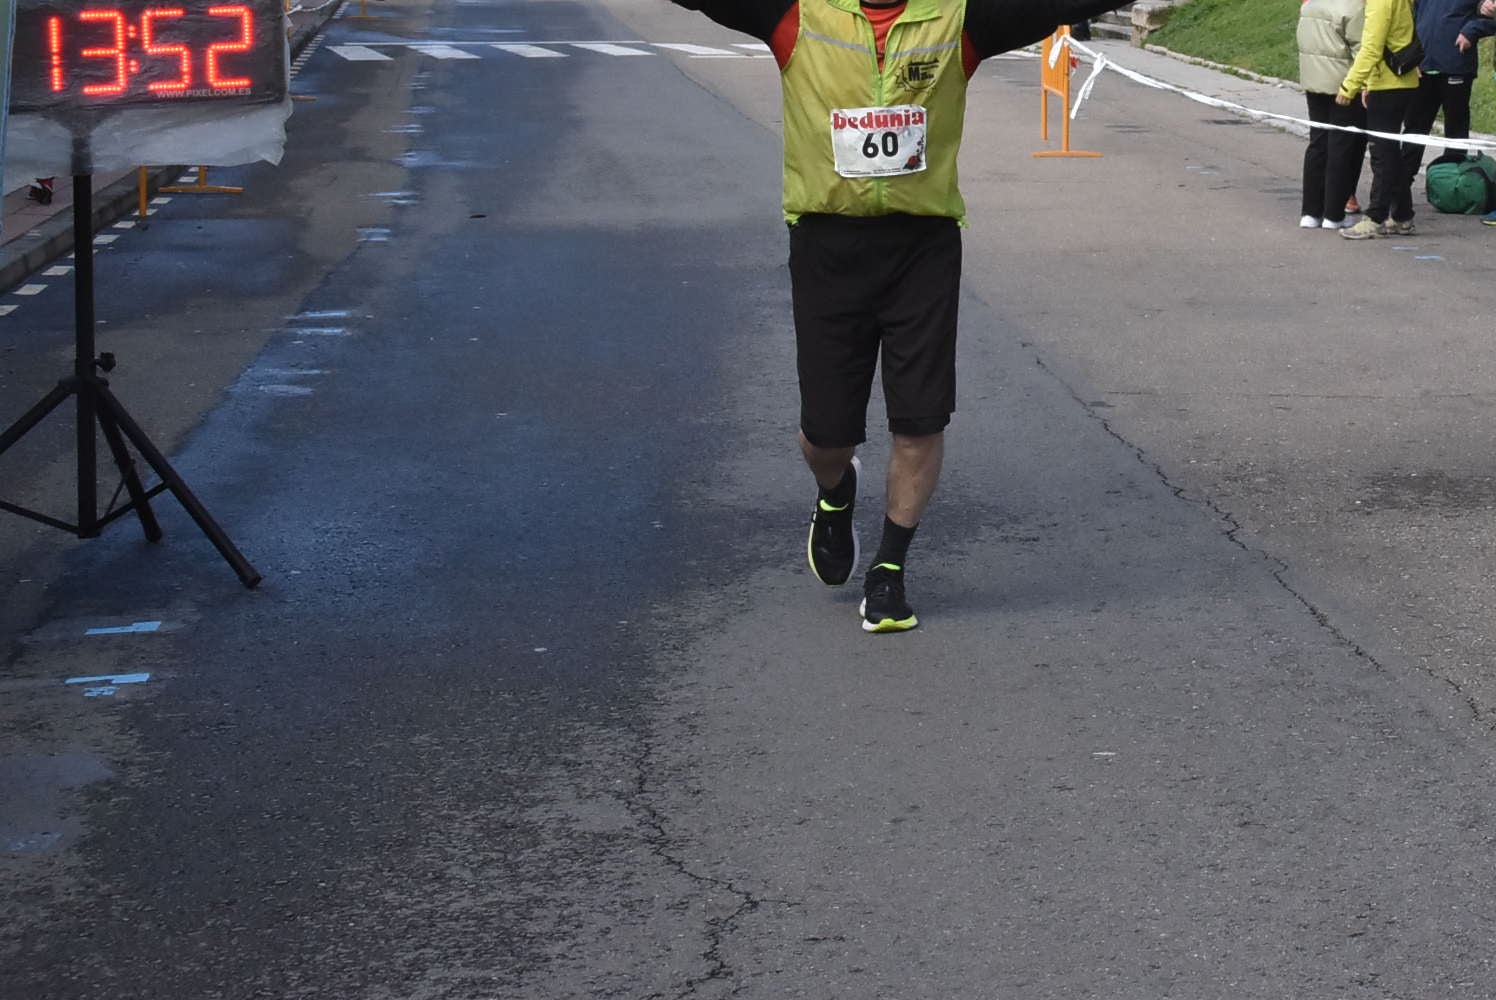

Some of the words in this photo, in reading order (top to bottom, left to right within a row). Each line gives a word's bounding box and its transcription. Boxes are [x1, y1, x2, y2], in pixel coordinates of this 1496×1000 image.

[49, 6, 253, 94] 13:52
[155, 87, 252, 99] WWW.PIXELCOM.ES
[833, 109, 925, 130] bedunia
[862, 131, 899, 158] 60
